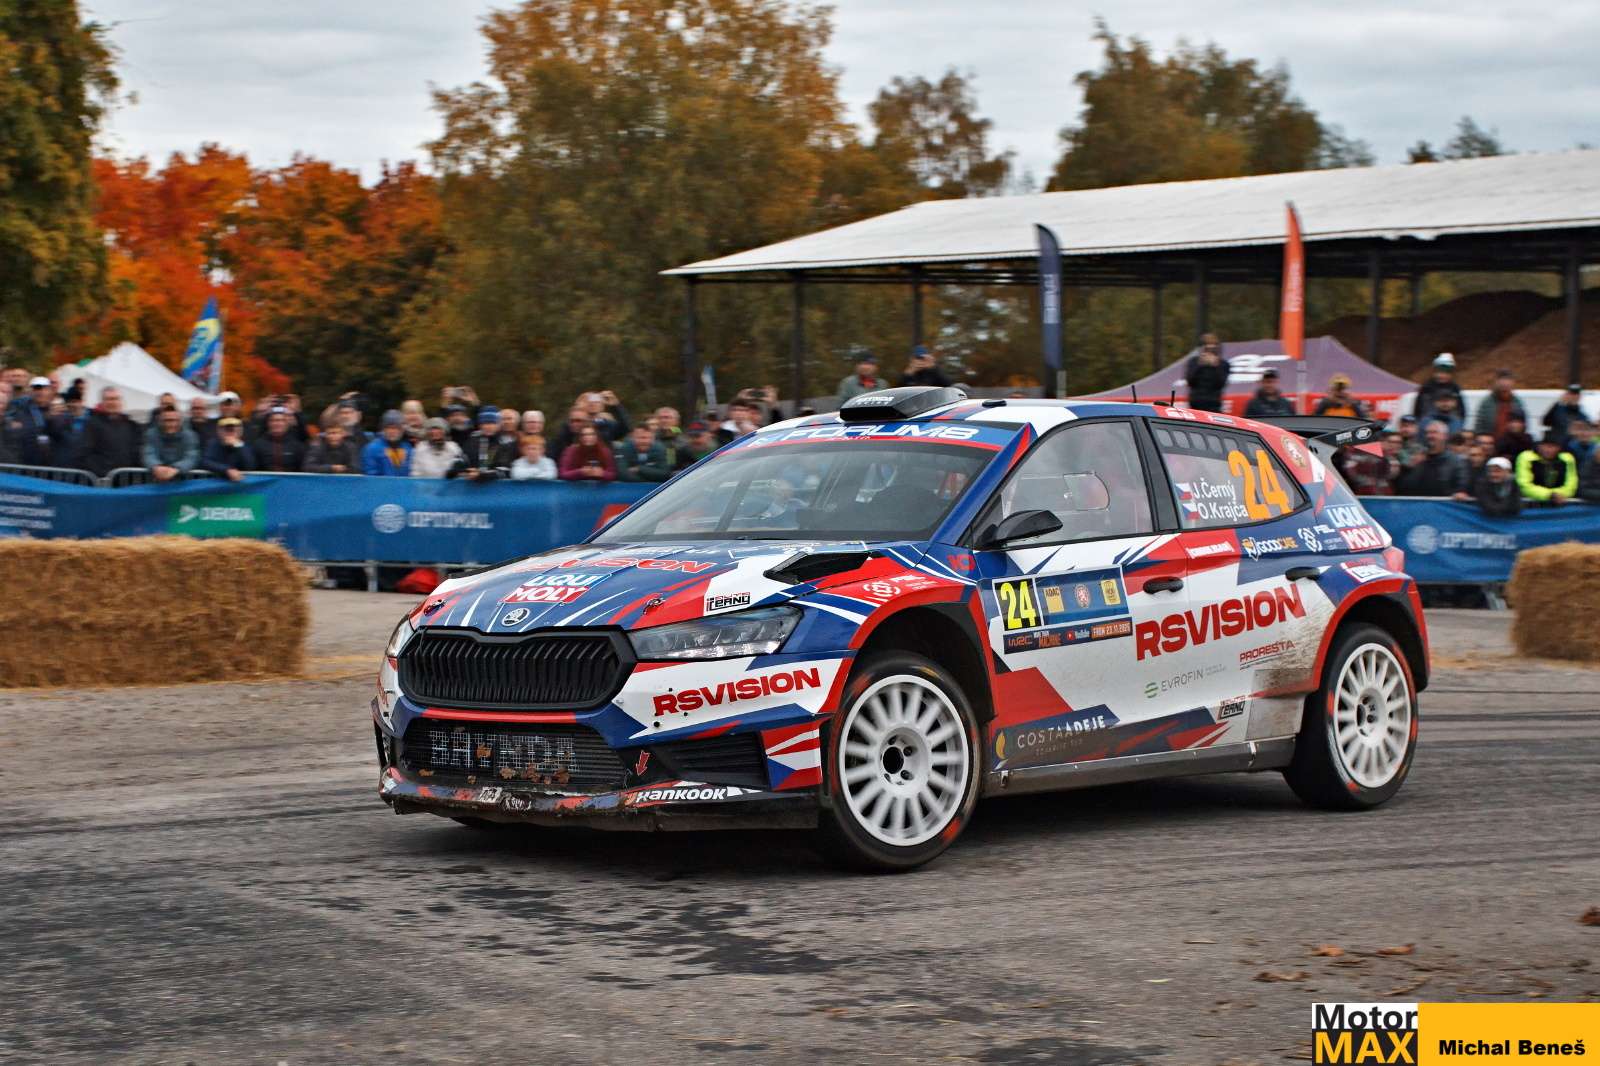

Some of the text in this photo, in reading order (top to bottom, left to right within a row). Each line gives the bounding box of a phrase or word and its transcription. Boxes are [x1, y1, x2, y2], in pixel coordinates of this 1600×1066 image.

[780, 422, 980, 441] FORUM8
[1228, 449, 1296, 520] 24
[1326, 506, 1369, 528] LIQUI
[1340, 527, 1381, 549] MOLY
[524, 573, 600, 586] LIQUI
[508, 586, 588, 601] MOLY
[1000, 580, 1038, 630] 24
[1136, 583, 1307, 662] RSVISION
[1239, 639, 1296, 663] PRORESTA
[1161, 668, 1204, 692] EVROFIN
[653, 667, 822, 718] RSVISION
